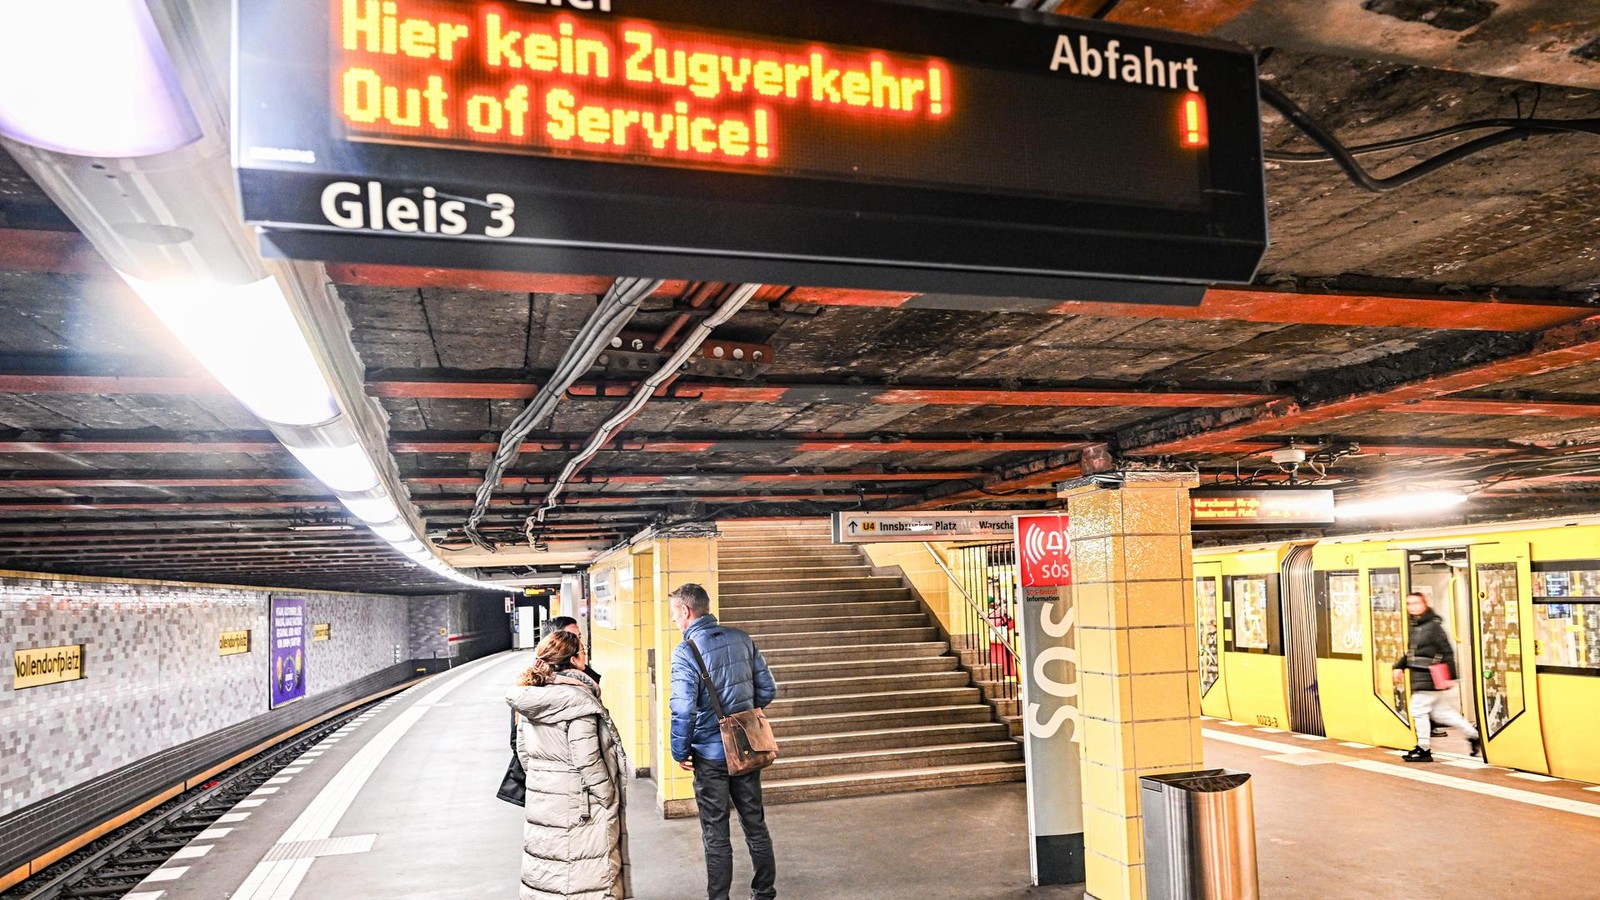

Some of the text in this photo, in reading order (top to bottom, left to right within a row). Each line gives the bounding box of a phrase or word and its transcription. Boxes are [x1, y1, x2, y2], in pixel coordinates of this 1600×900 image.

[342, 0, 942, 115] Hier kein Zugverkehr!
[1050, 35, 1199, 92] Abfahrt
[342, 66, 769, 159] Out of Service!
[1186, 100, 1199, 143] !
[321, 181, 516, 238] Gleis 3
[862, 521, 876, 531] U4
[935, 521, 957, 531] Platz
[1041, 562, 1070, 580] SOS
